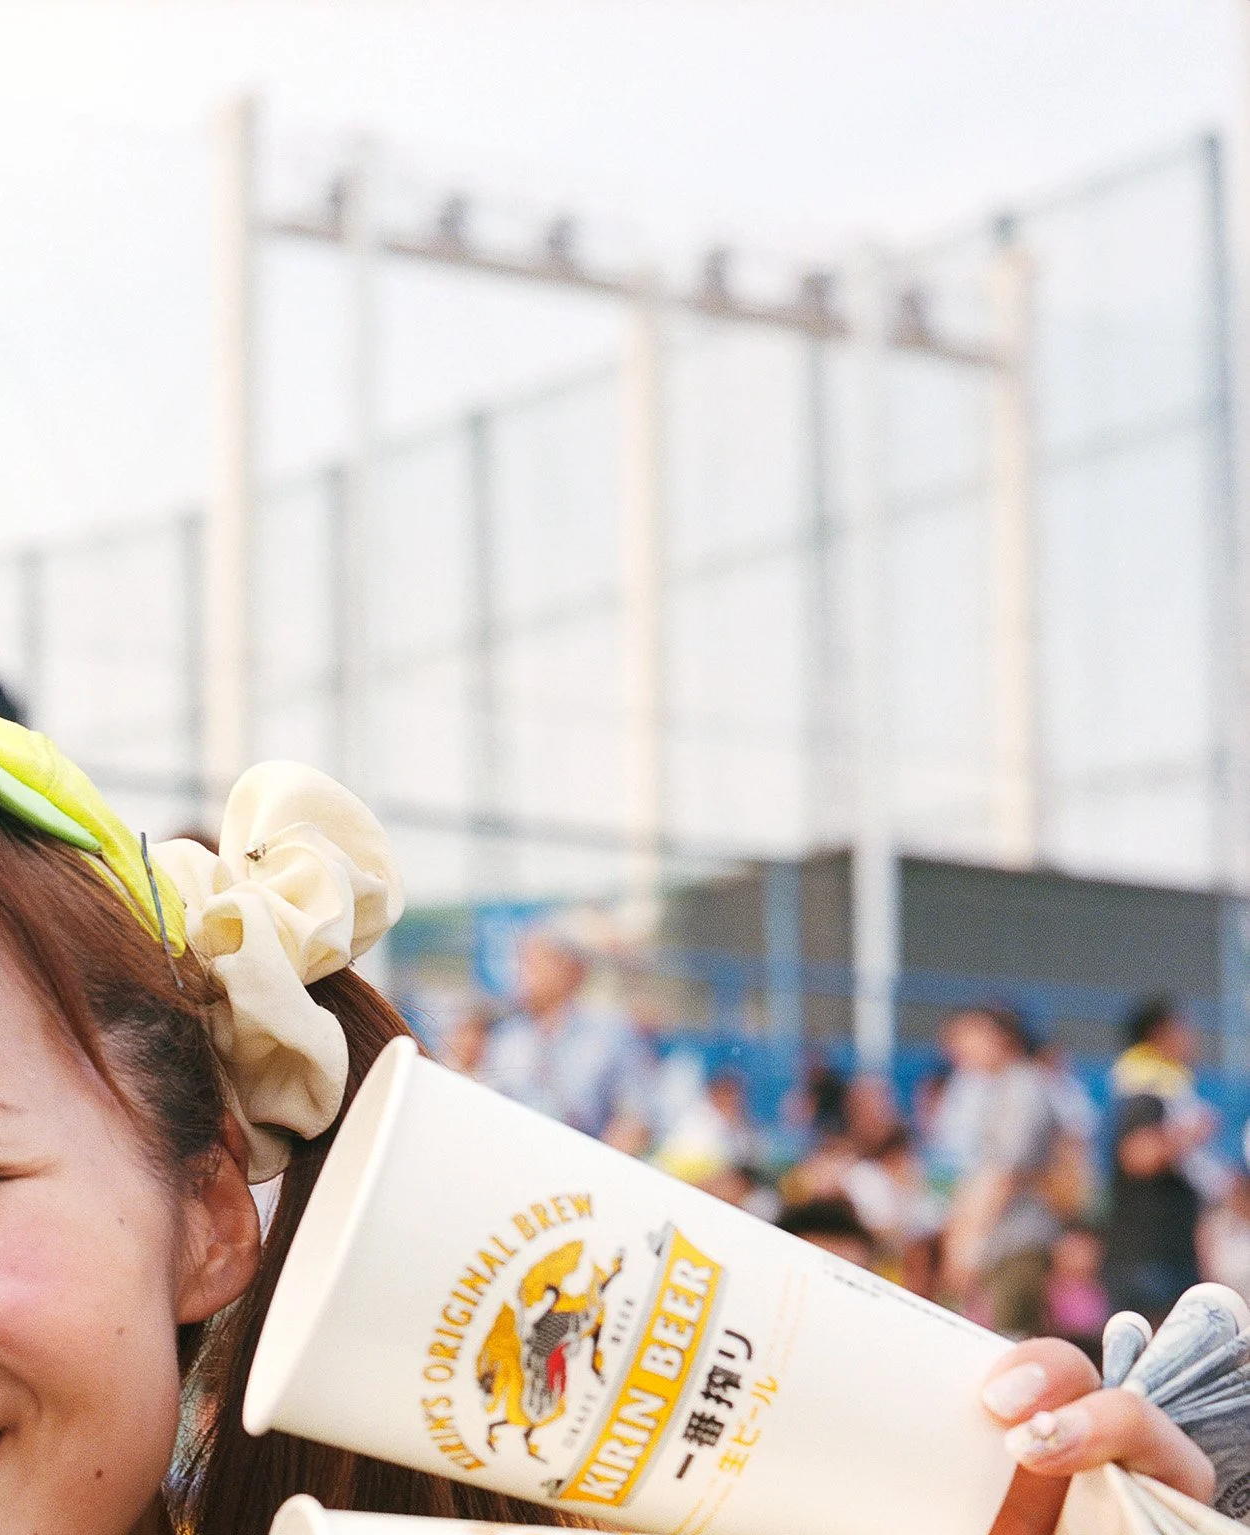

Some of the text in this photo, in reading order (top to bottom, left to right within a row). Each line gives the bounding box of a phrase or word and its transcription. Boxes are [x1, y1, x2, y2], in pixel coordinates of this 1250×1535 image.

[422, 1233, 519, 1383] ORIGINAL
[511, 1193, 594, 1242] BREW
[577, 1256, 714, 1500] KIRIN BEER
[675, 1328, 754, 1480] 一番搾り
